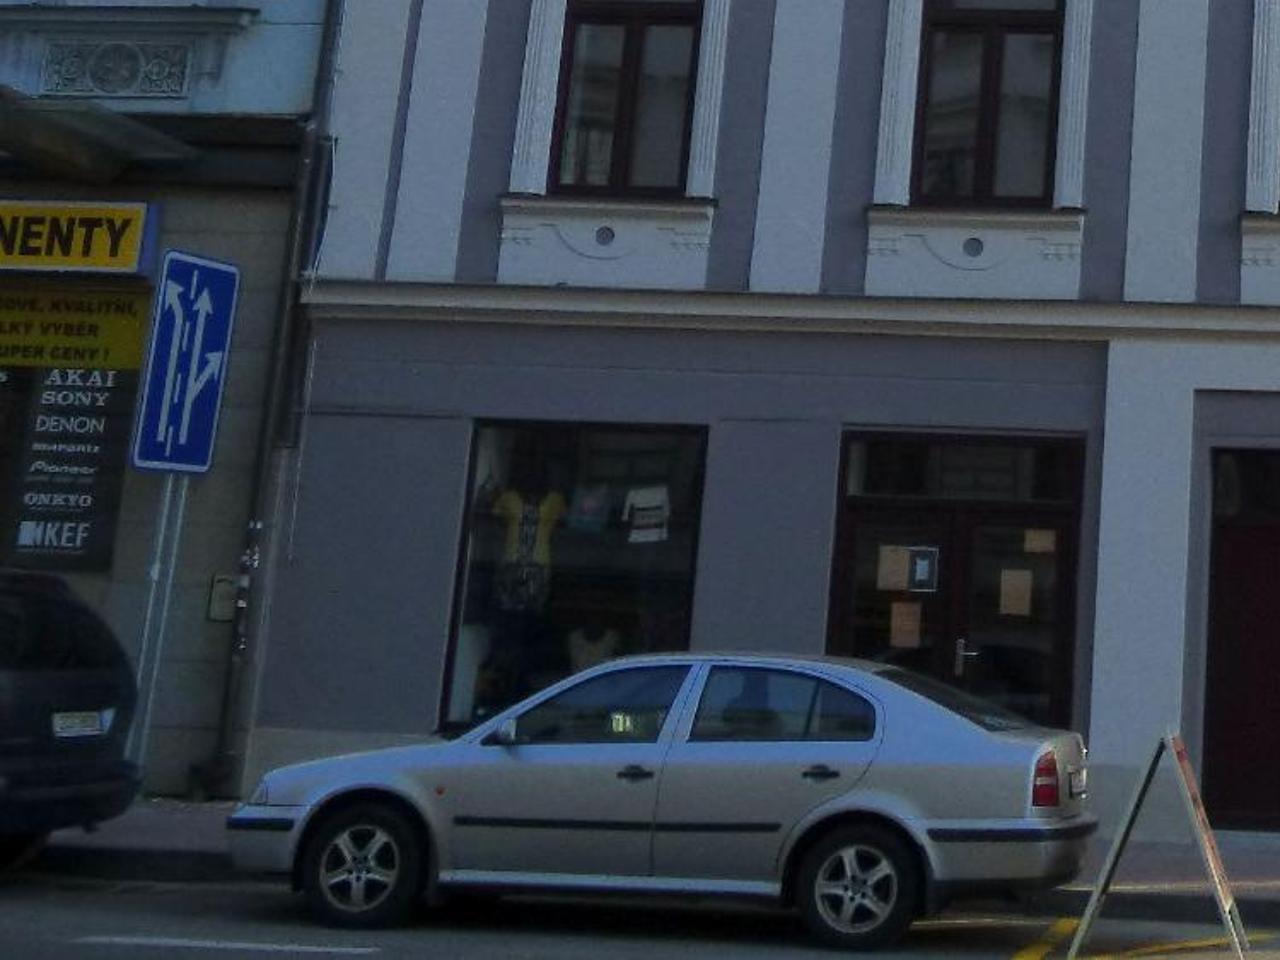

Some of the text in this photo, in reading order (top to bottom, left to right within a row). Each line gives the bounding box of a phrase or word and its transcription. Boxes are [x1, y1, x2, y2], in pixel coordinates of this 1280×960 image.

[44, 368, 118, 387] AKAI
[40, 390, 110, 407] SONY
[35, 415, 106, 434] DENON
[23, 492, 93, 508] ONKYO
[43, 522, 91, 547] KEF
